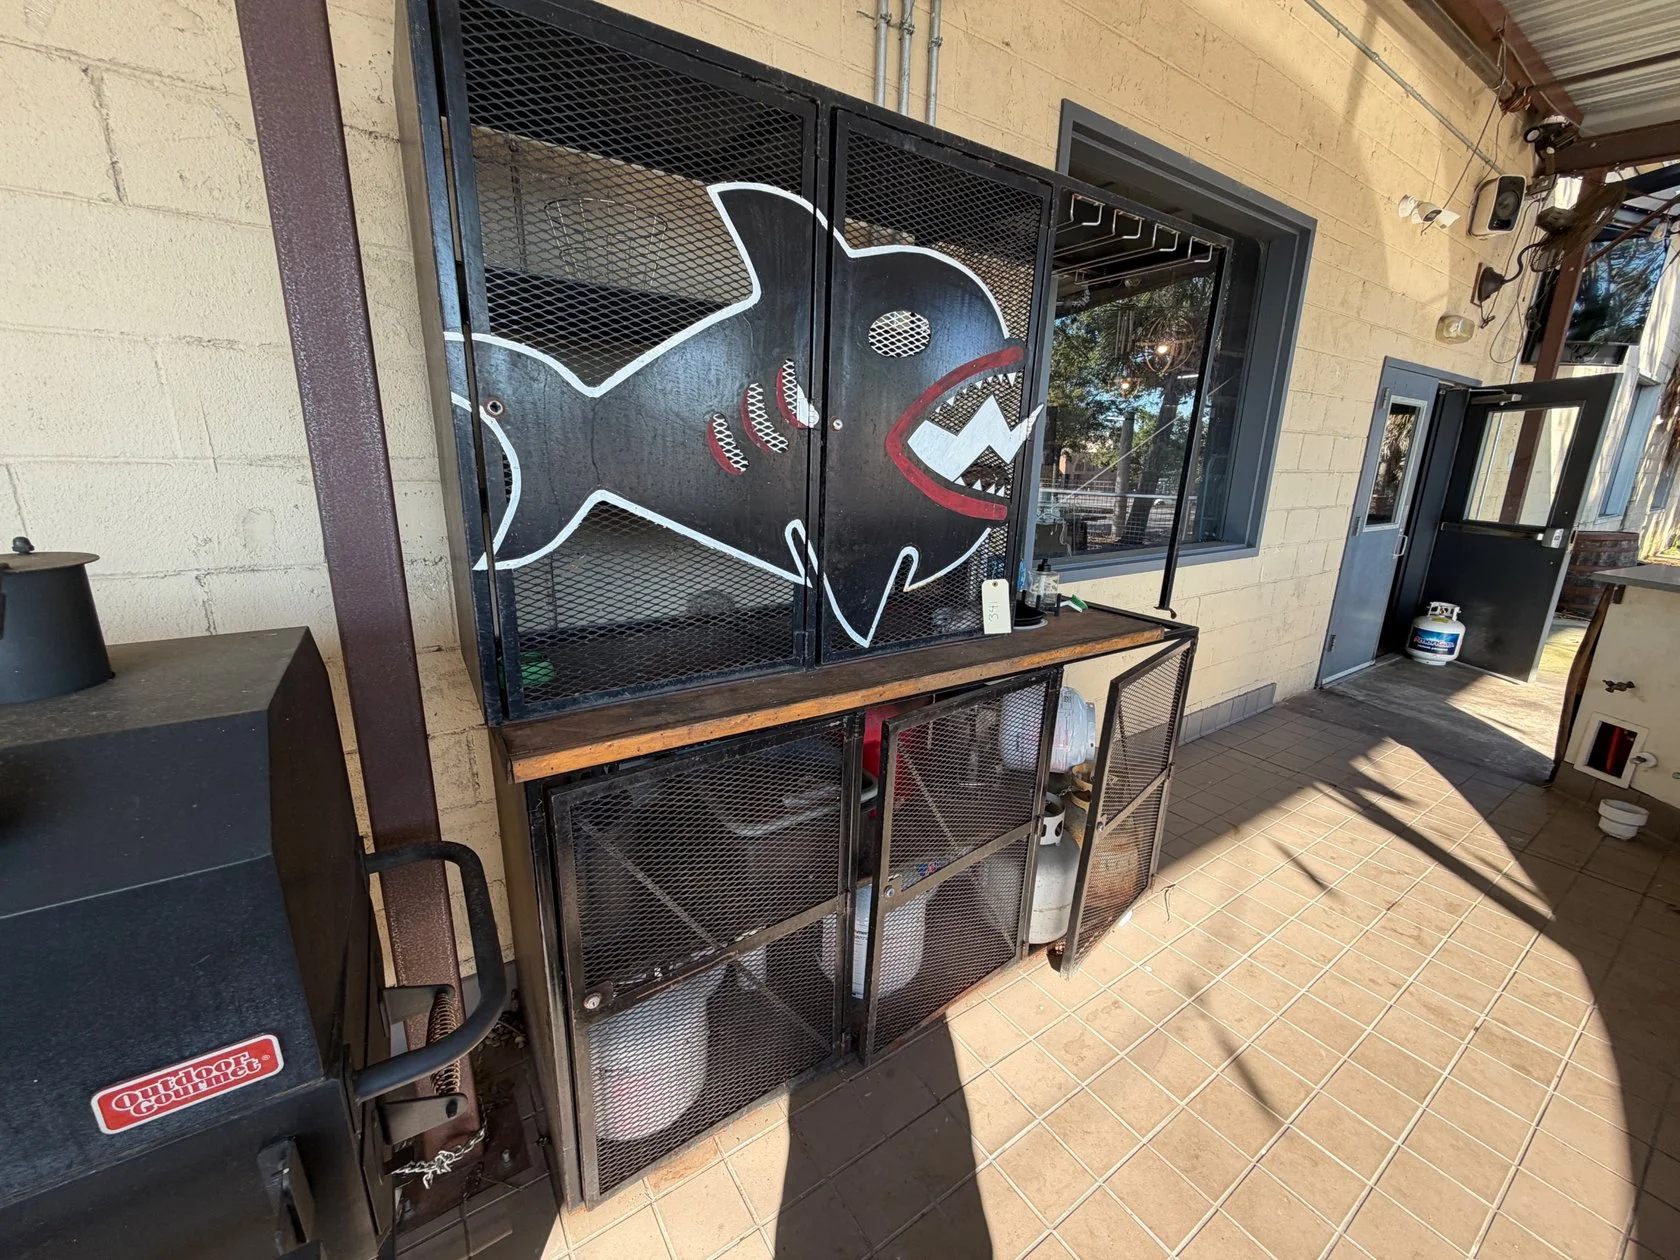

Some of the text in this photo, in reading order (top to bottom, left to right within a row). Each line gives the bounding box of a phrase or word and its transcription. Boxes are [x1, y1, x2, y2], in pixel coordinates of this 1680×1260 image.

[987, 601, 999, 622] 341
[112, 1051, 249, 1112] Outdoor
[130, 1058, 262, 1117] Gourmet
